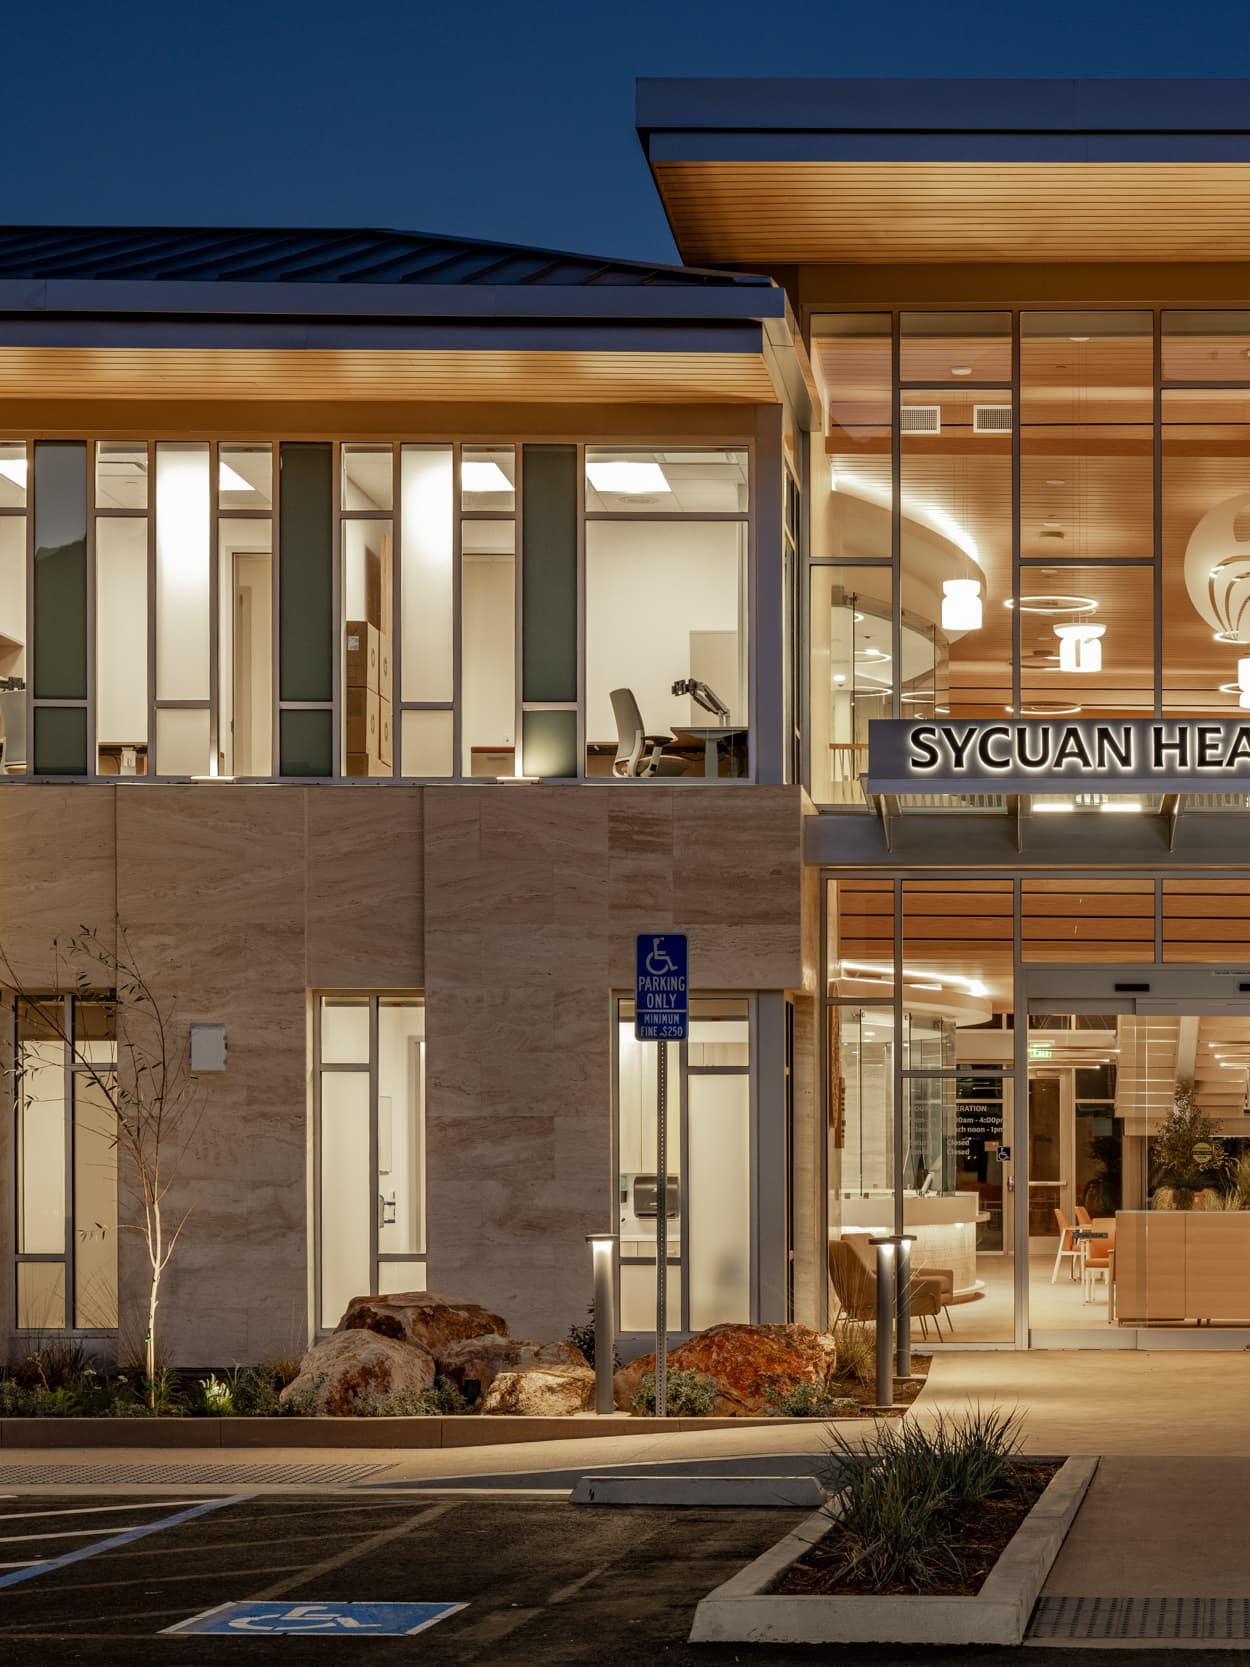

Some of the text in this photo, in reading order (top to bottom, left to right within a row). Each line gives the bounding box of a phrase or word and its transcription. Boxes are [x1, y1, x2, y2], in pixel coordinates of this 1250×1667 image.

[909, 726, 1133, 770] SYCUAN
[638, 976, 686, 991] PARKING
[646, 993, 677, 1009] ONLY
[644, 1013, 680, 1024] MINIMUM
[640, 1026, 683, 1037] FINE $250
[946, 1138, 970, 1146] Closed
